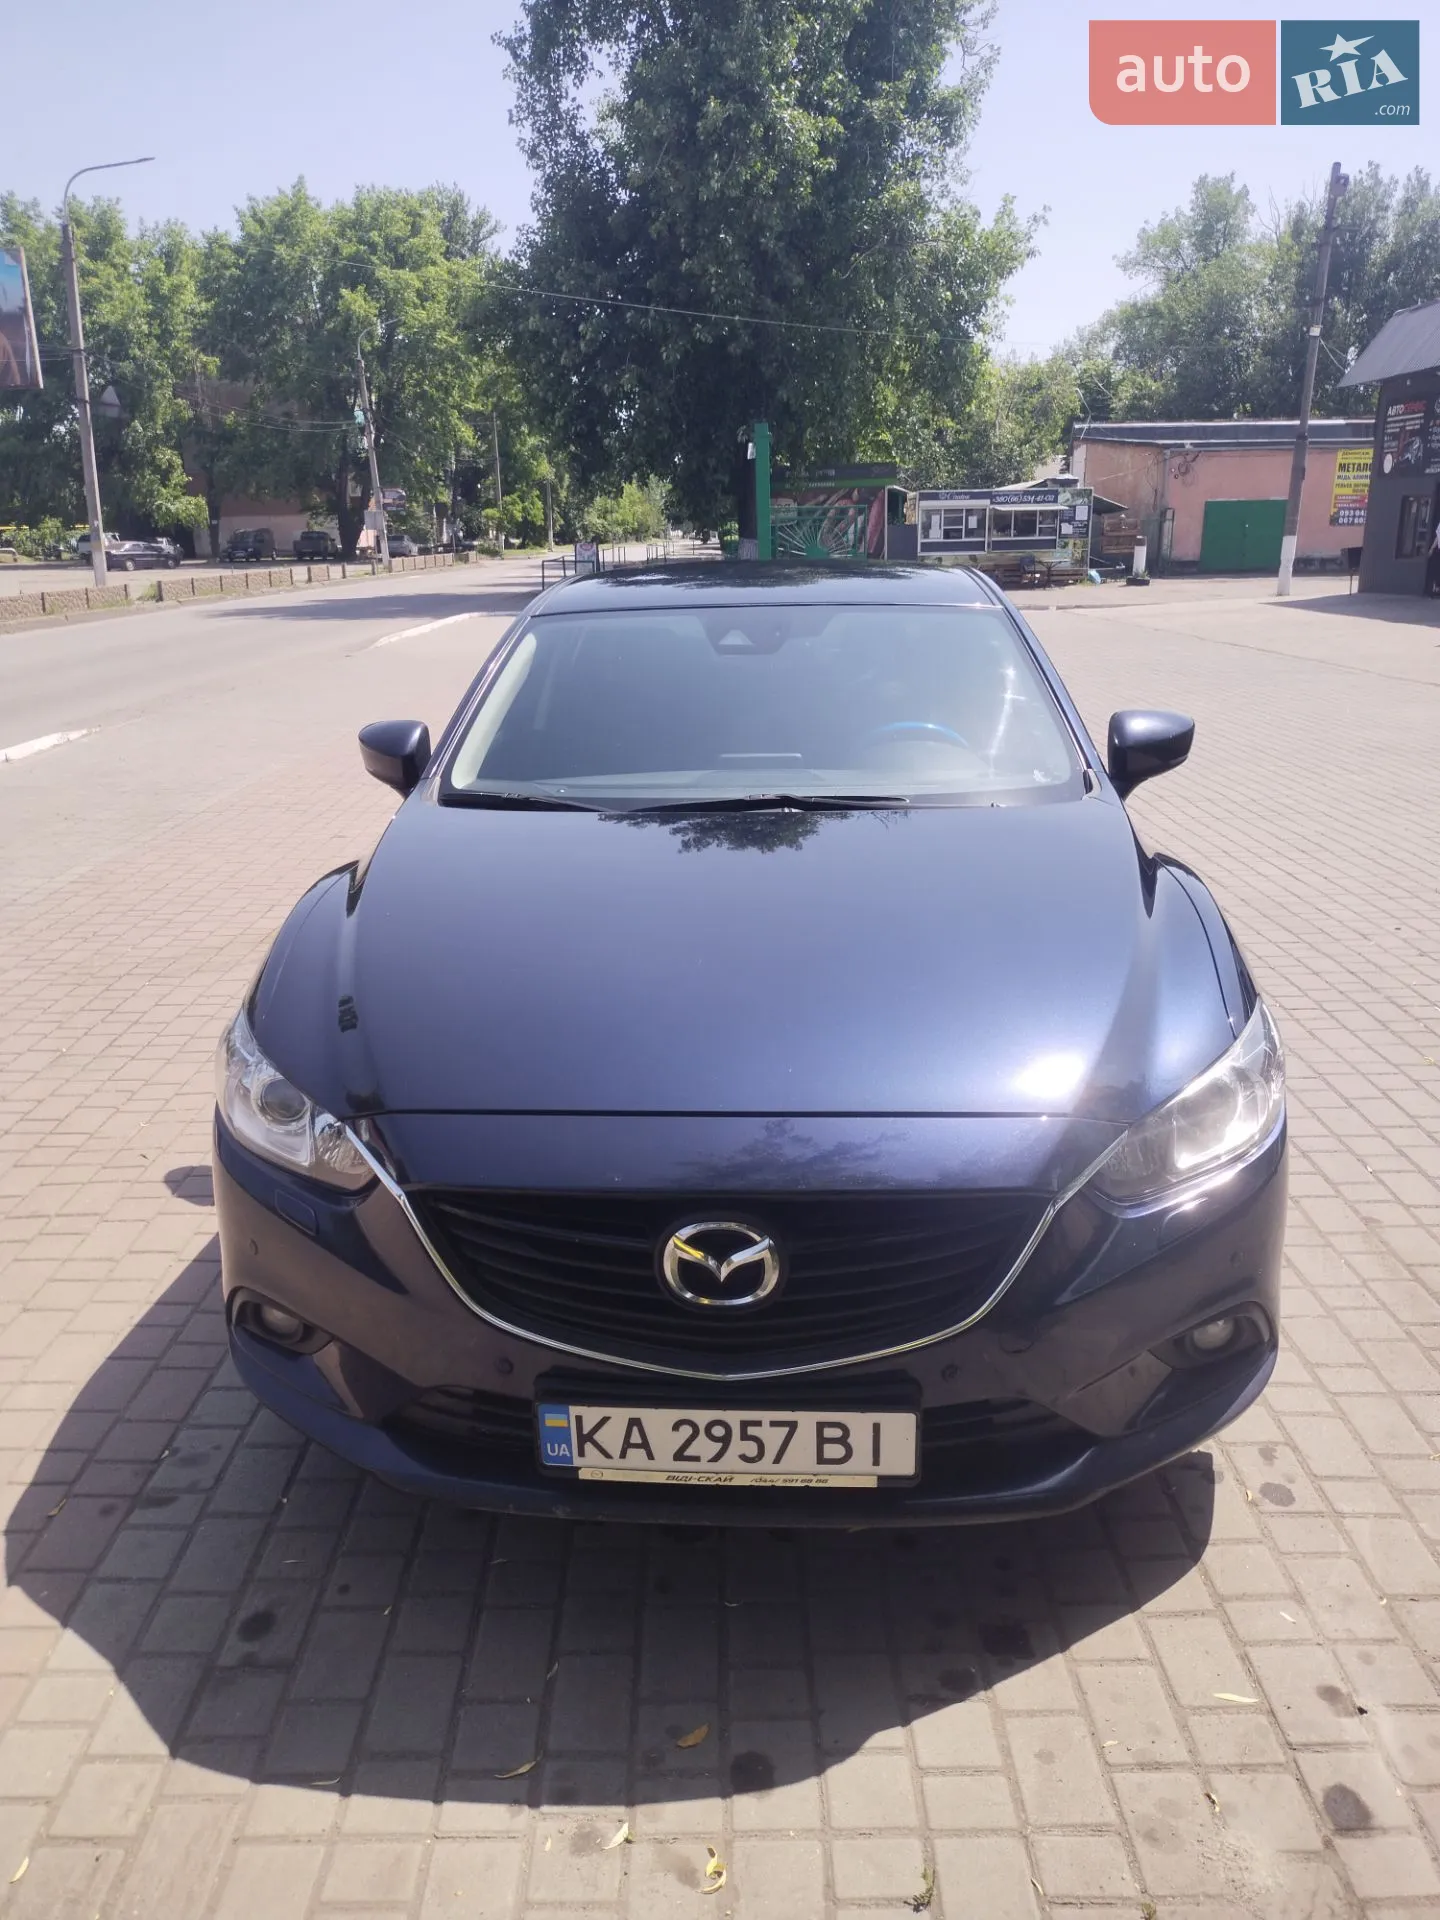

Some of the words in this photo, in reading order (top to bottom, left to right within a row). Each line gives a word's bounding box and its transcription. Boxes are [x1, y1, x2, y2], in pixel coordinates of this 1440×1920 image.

[1354, 509, 1367, 517] 04
[575, 1414, 655, 1461] KA
[671, 1418, 799, 1465] 2957
[816, 1421, 881, 1467] BI
[546, 1443, 571, 1457] UA
